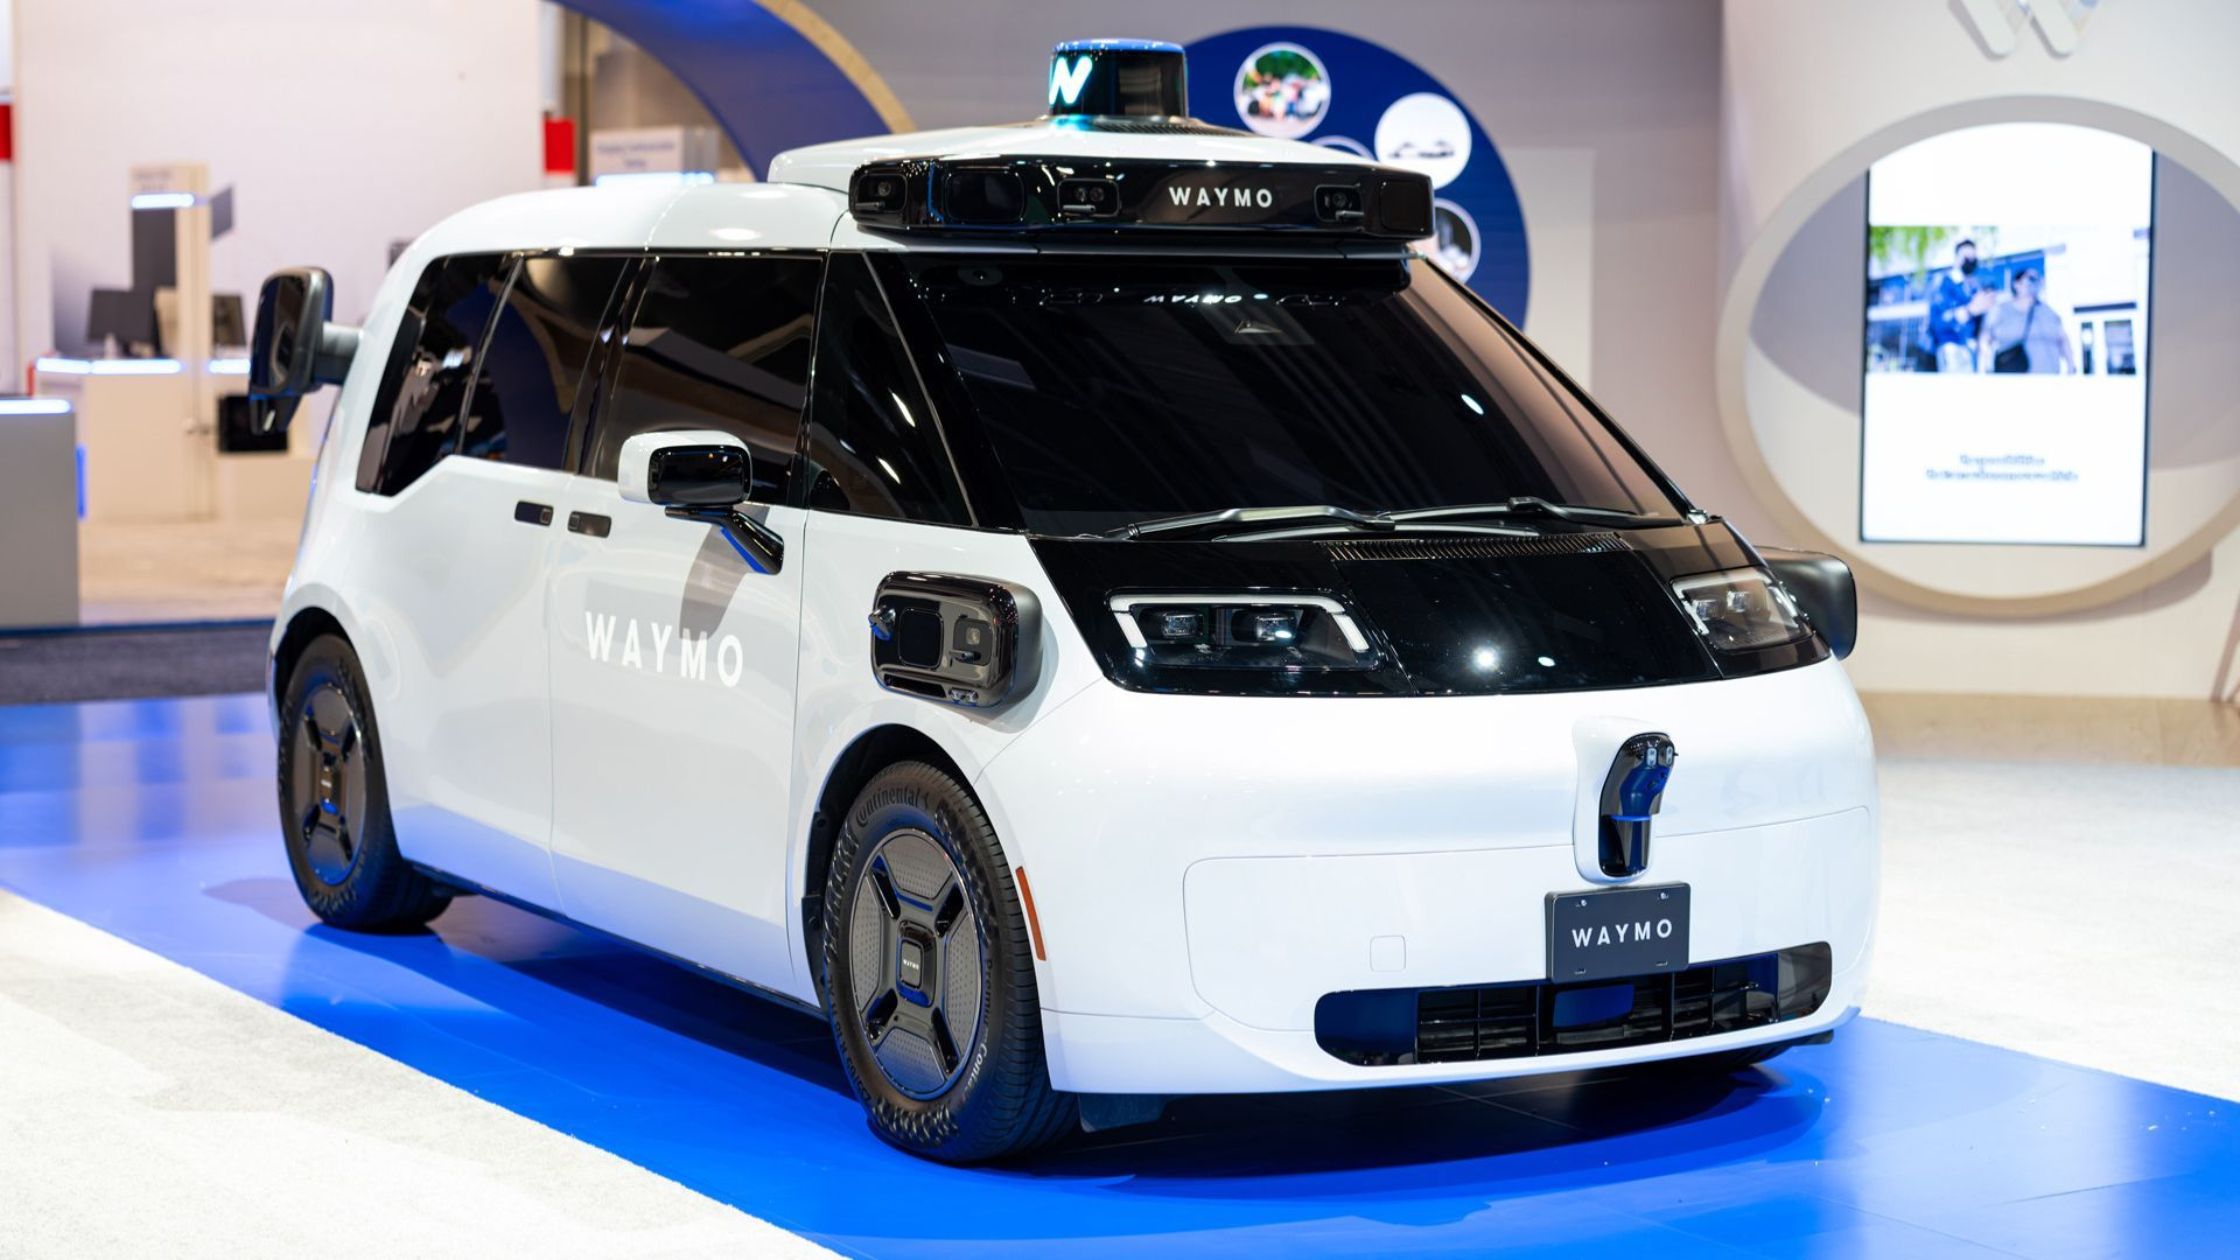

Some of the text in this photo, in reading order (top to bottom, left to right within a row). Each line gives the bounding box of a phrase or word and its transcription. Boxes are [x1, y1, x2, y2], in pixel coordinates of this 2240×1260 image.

[1168, 186, 1272, 208] WAYMO
[585, 611, 744, 688] WAYMO
[855, 786, 921, 828] Continental
[1571, 918, 1672, 948] WAYMO
